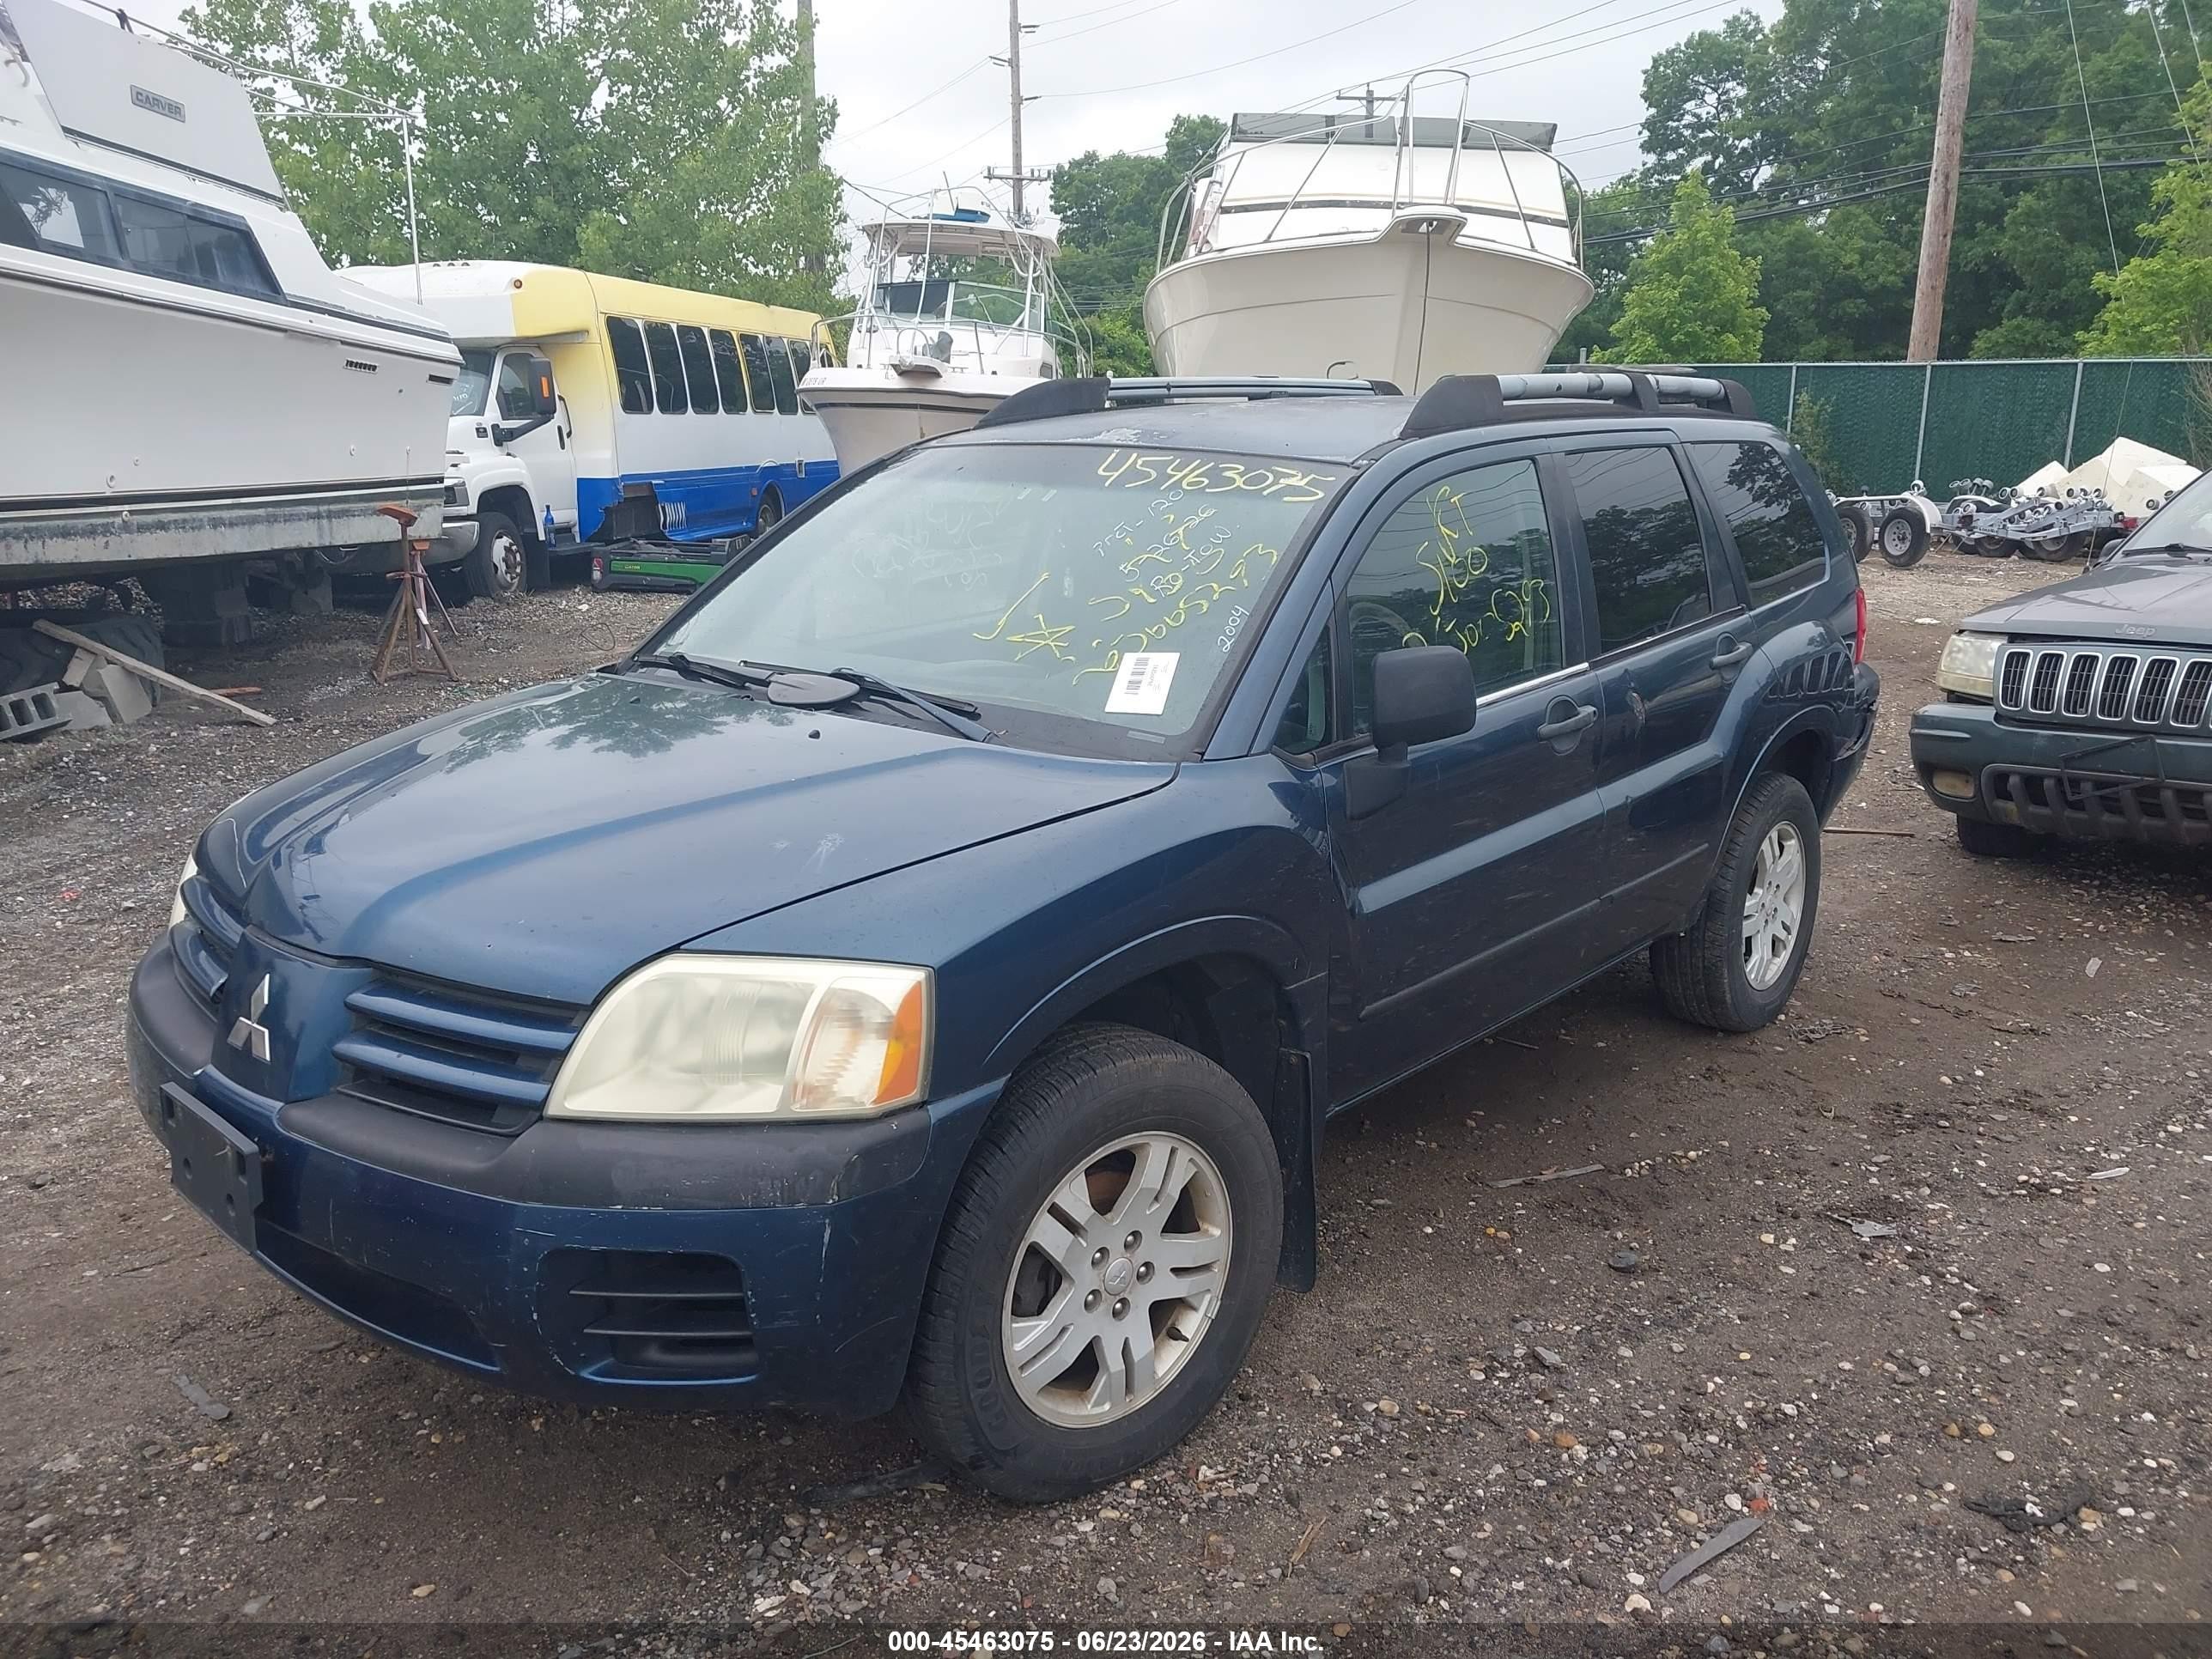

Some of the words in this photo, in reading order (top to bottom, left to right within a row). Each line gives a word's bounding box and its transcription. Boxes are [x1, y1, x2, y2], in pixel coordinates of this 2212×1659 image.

[136, 90, 182, 118] CARVER
[1097, 449, 1336, 502] 45463075
[1217, 605, 1250, 653] 2004
[2115, 623, 2156, 638] Jeep
